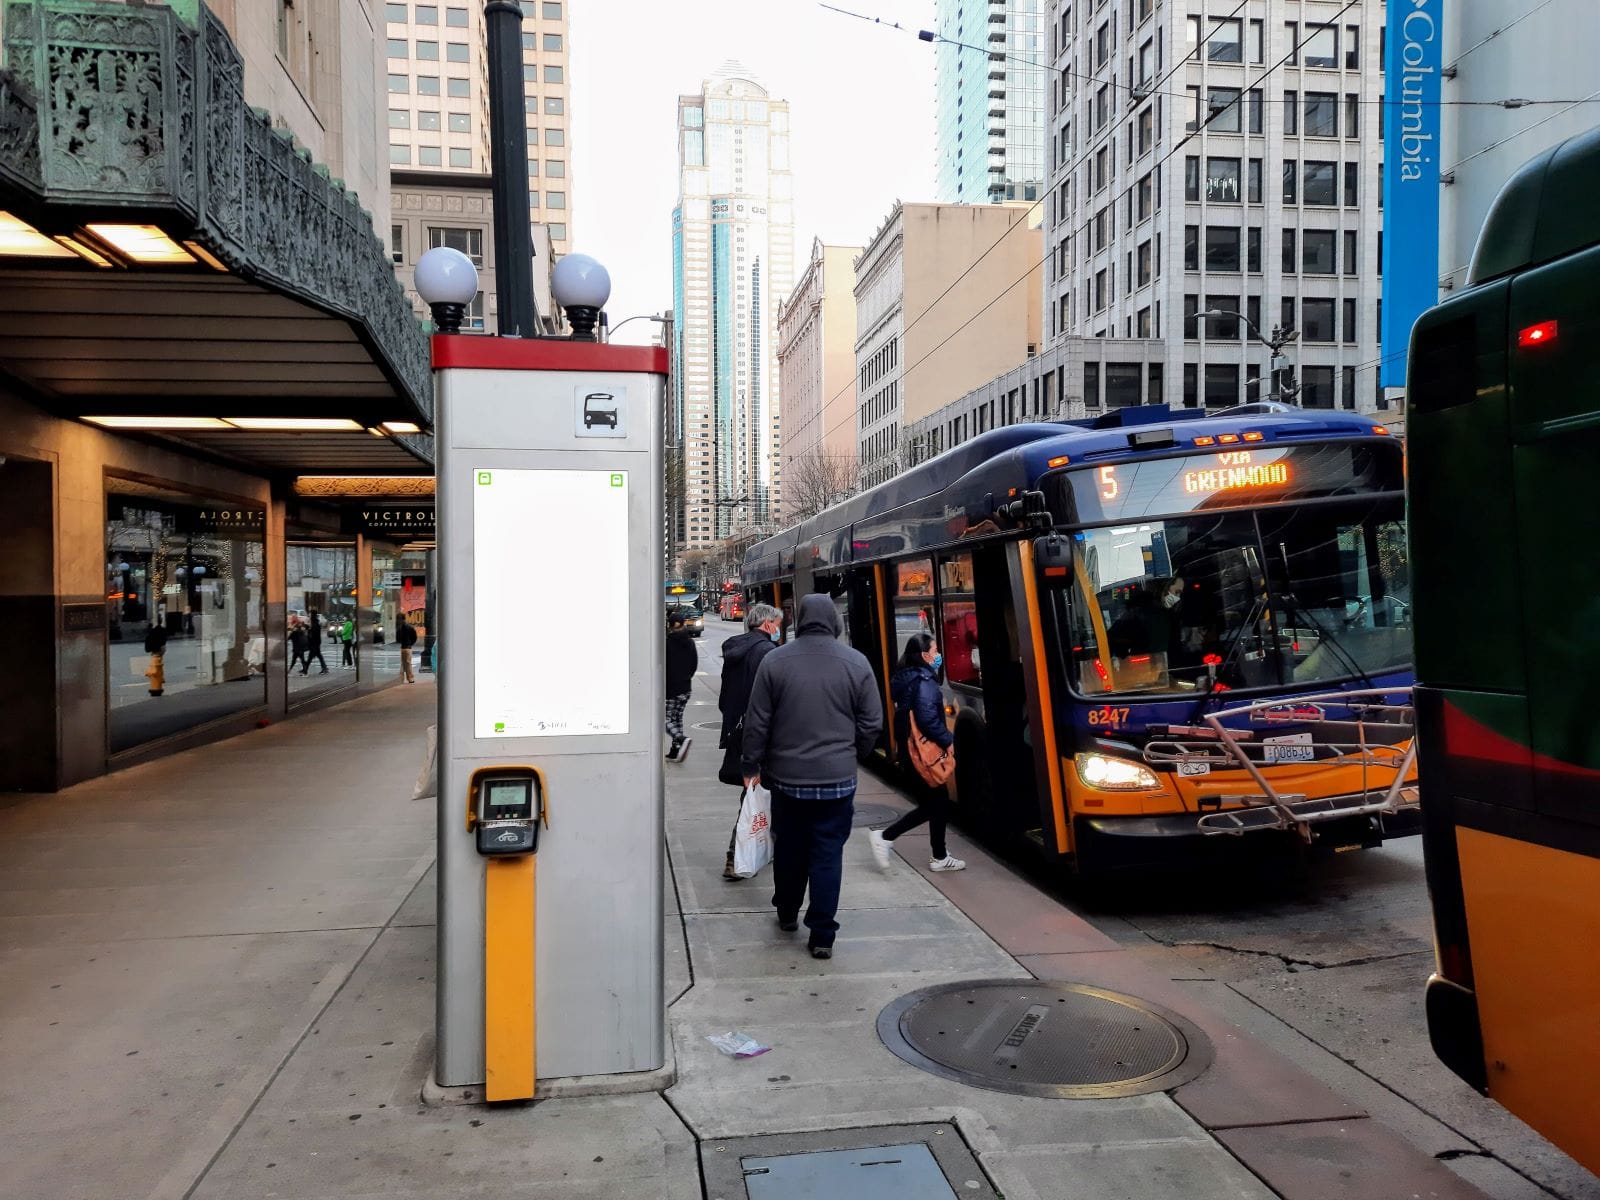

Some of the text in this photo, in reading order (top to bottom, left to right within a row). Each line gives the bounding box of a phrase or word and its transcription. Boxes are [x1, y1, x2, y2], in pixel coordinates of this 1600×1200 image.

[1402, 10, 1435, 183] Columbia
[1218, 451, 1251, 465] VIA
[1101, 466, 1118, 499] 5
[1185, 463, 1287, 493] GREENWOOD
[1088, 708, 1130, 725] 8247
